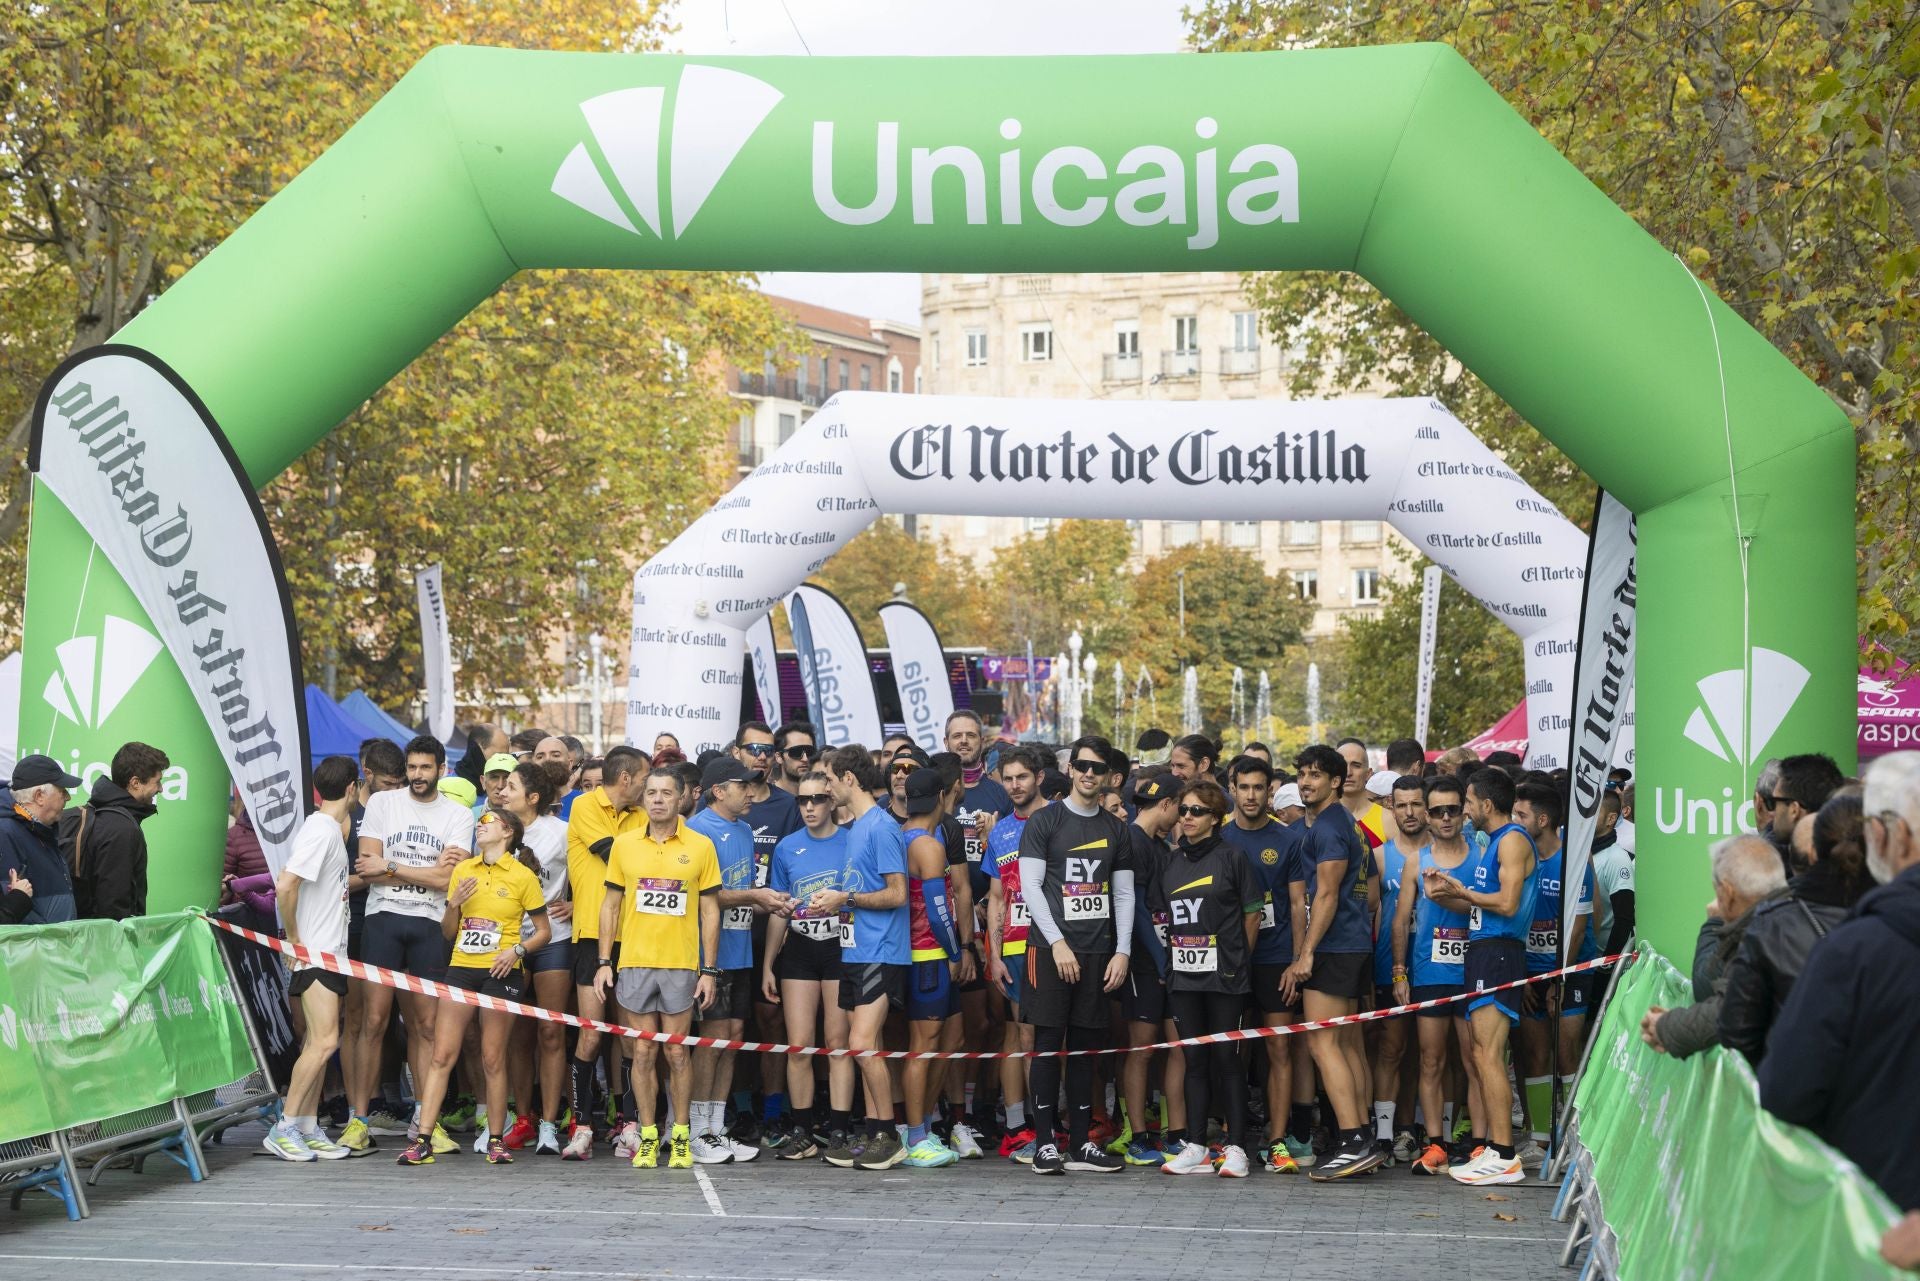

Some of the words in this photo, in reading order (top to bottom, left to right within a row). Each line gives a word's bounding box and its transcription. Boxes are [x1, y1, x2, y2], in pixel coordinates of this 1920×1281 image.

[811, 116, 1301, 250] Unicaja
[889, 423, 953, 480] El
[962, 424, 1099, 485] Norte
[1107, 431, 1160, 485] de
[1167, 428, 1371, 487] Castilla
[795, 460, 843, 476] Castilla
[1417, 461, 1434, 477] El
[1436, 461, 1470, 476] Norte
[1471, 463, 1484, 475] de
[816, 497, 833, 512] El
[836, 497, 868, 511] Norte
[1396, 499, 1445, 513] Castilla
[1515, 499, 1531, 512] El
[721, 529, 737, 543] El
[740, 529, 773, 545] Norte
[775, 532, 787, 545] de
[789, 531, 836, 546] Castilla
[1426, 533, 1441, 547] El
[1442, 534, 1475, 548] Norte
[1476, 534, 1489, 548] de
[1491, 531, 1543, 547] Castilla
[653, 563, 680, 577] Norte
[681, 562, 693, 576] de
[694, 563, 744, 579] Castilla
[1521, 567, 1538, 583] El
[1540, 566, 1575, 581] Norte
[716, 600, 731, 613] El
[735, 600, 766, 612] Norte
[1501, 603, 1547, 618] Castilla
[641, 627, 665, 643] Norte
[681, 630, 727, 648] Castilla
[1535, 641, 1547, 657] El
[701, 669, 716, 684] El
[1584, 612, 1632, 745] Norte
[635, 700, 659, 717] Norte
[661, 703, 674, 718] de
[675, 703, 721, 720] Castilla
[1574, 745, 1607, 819] El
[1065, 857, 1102, 883] EY
[643, 892, 679, 909] 228
[1071, 896, 1103, 913] 309
[1170, 897, 1204, 926] EY
[799, 918, 832, 935] 371
[463, 931, 492, 947] 226
[1528, 932, 1558, 947] 566
[1178, 949, 1209, 965] 307
